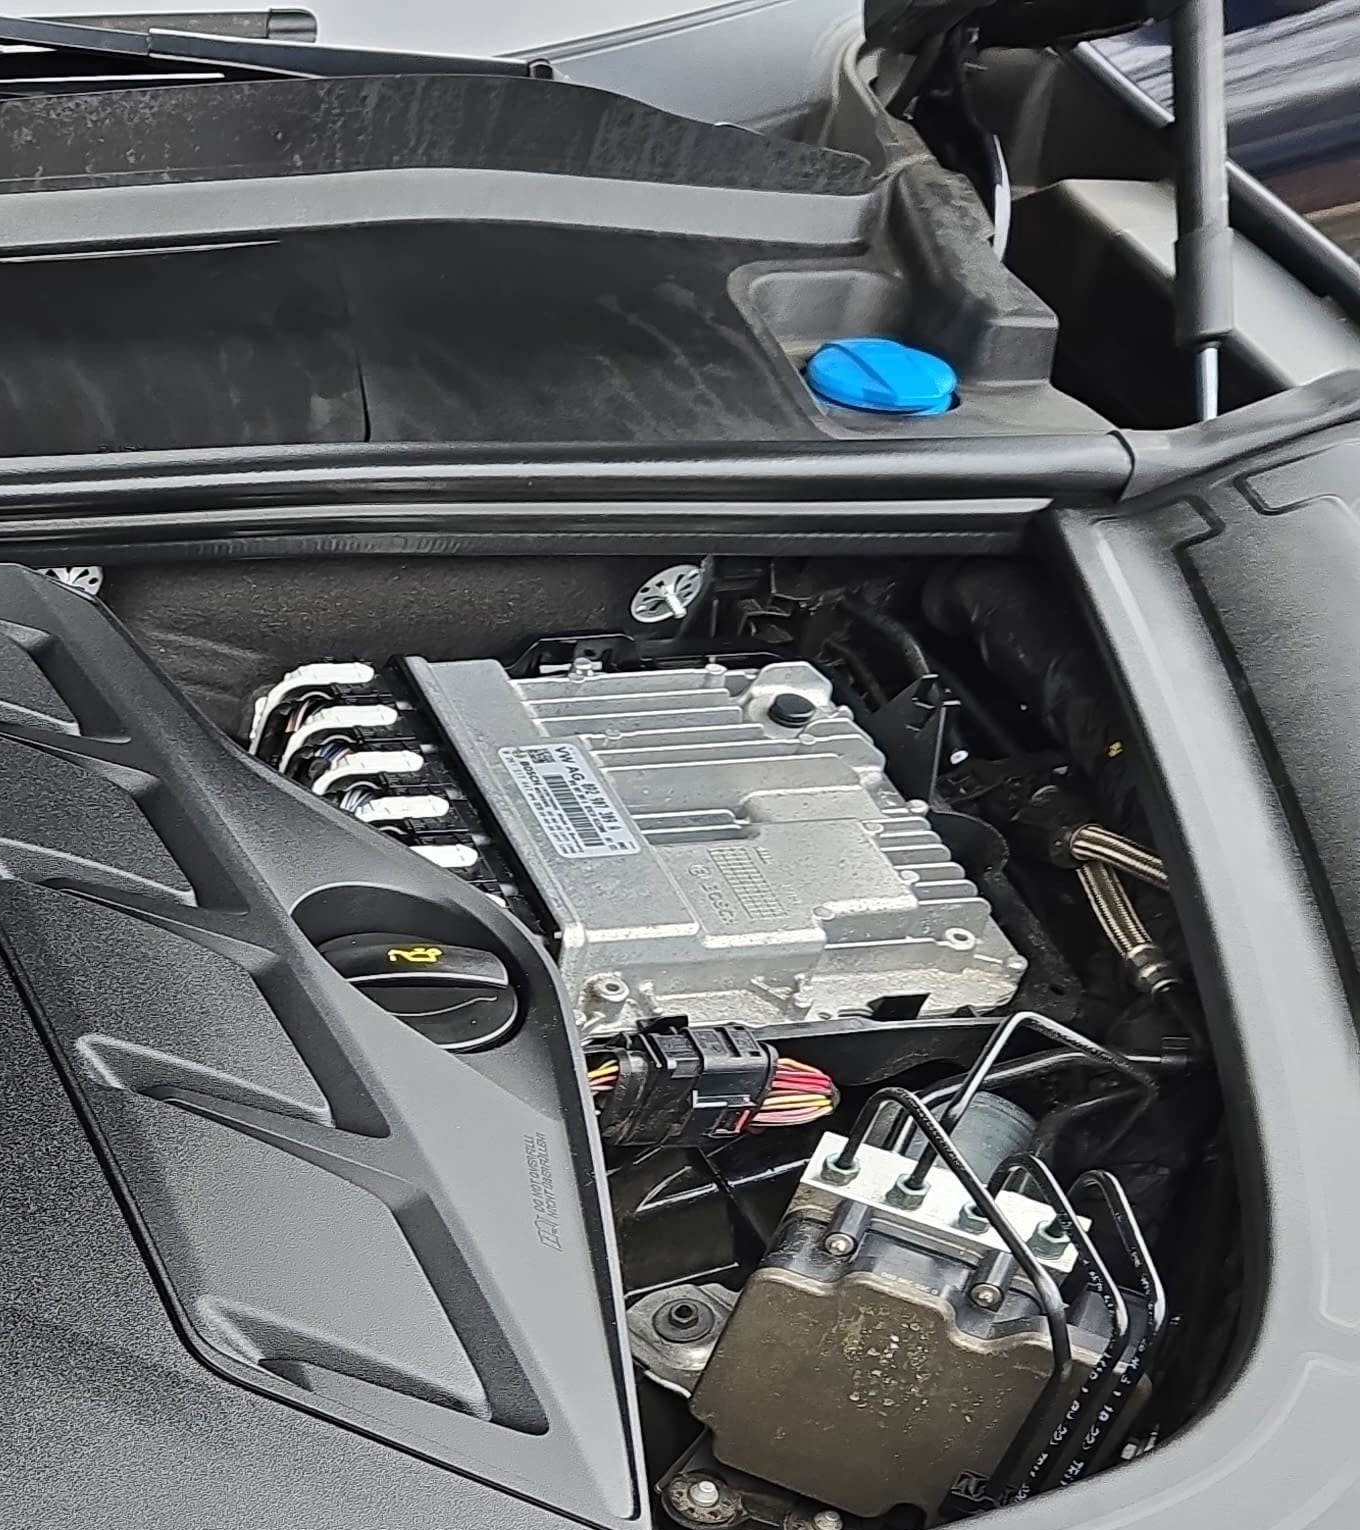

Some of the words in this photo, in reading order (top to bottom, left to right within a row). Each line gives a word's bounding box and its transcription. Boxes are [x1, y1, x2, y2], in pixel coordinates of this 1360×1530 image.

[520, 761, 542, 786] BOSCH
[555, 746, 575, 764] VW
[566, 766, 585, 781] AG
